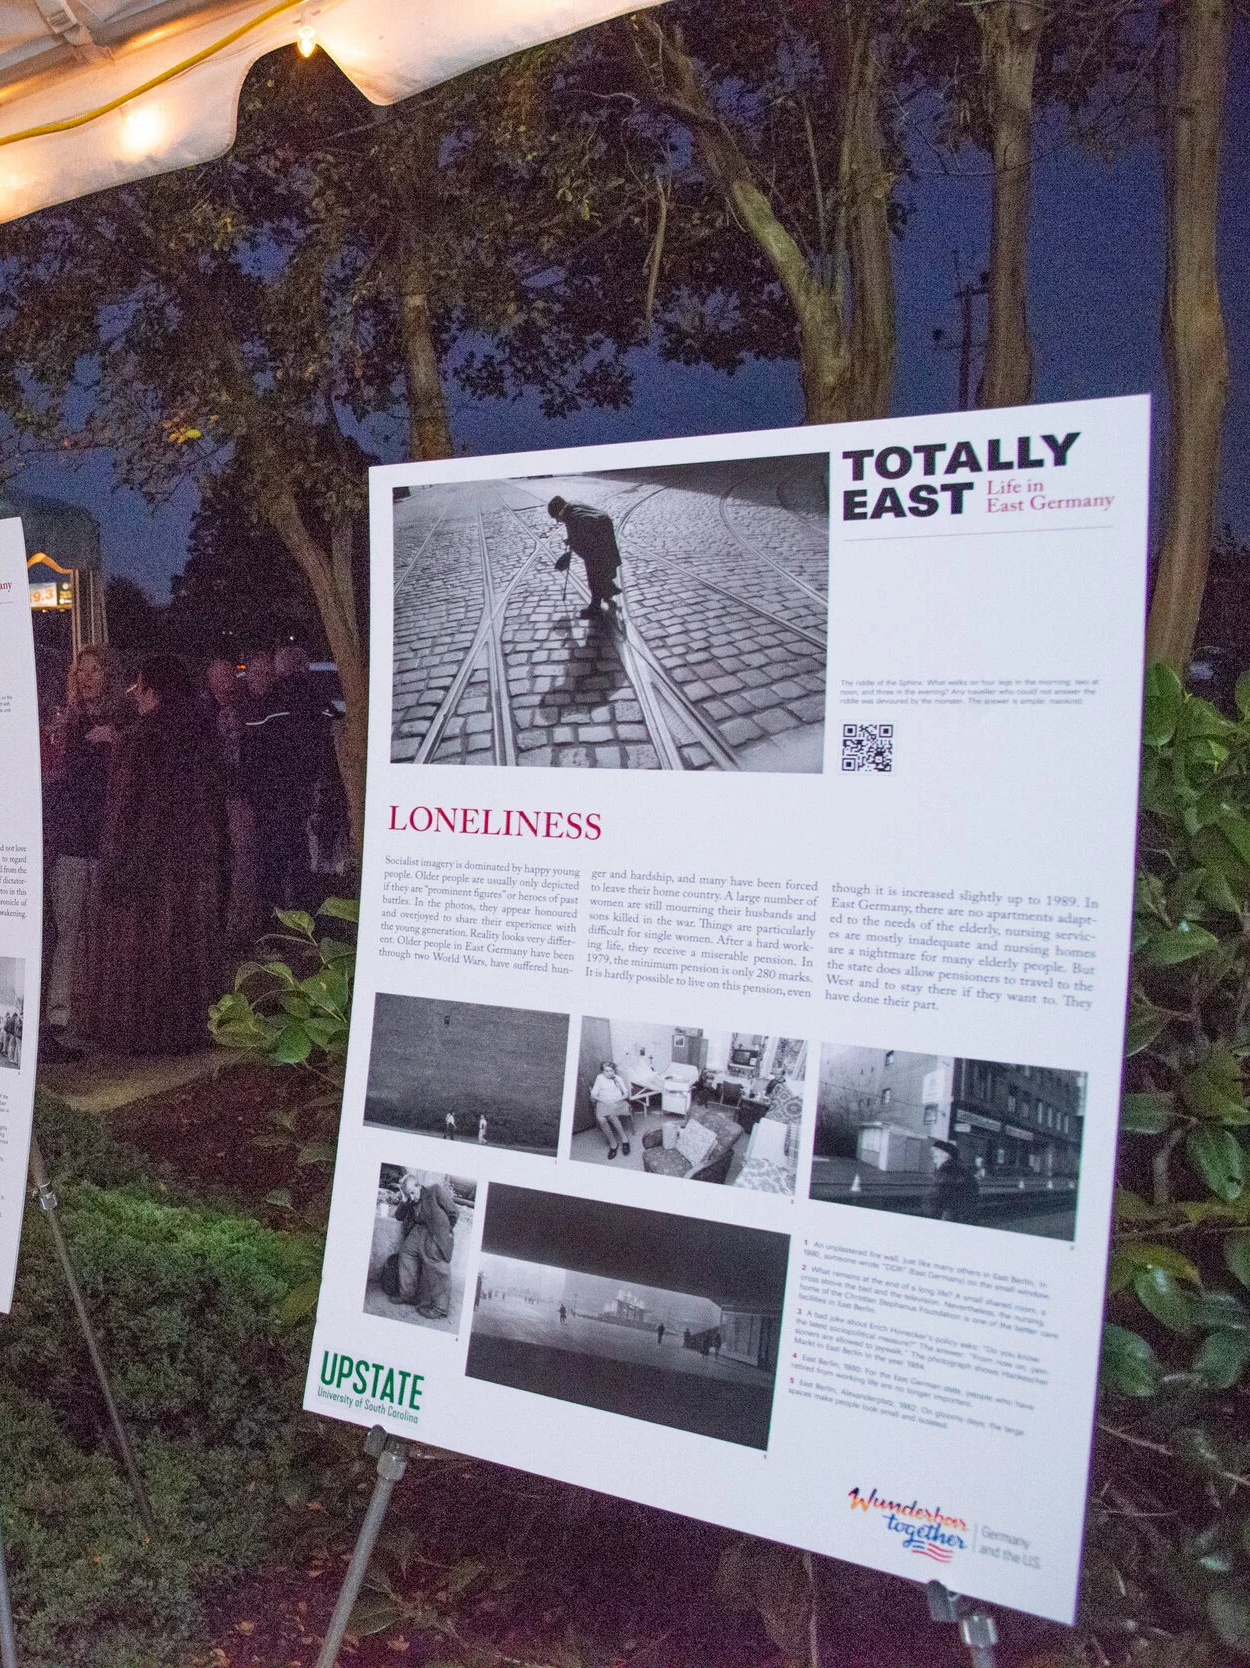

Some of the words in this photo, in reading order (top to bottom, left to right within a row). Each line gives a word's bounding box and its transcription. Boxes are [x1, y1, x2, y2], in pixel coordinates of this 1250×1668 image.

[842, 432, 1082, 481] TOTALLY
[986, 478, 1022, 496] Life
[1027, 480, 1044, 494] in
[843, 482, 974, 521] EAST
[985, 496, 1024, 514] East
[1030, 493, 1115, 512] Germany
[388, 805, 602, 840] LONELINESS
[384, 854, 419, 866] Socialist
[420, 858, 454, 871] imagery
[455, 860, 462, 869] is
[463, 859, 510, 872] dominated
[511, 862, 522, 876] by
[523, 863, 550, 877] happy
[552, 868, 580, 879] young
[414, 870, 440, 881] Older
[441, 872, 470, 886] people
[486, 874, 517, 889] usually
[518, 876, 539, 890] only
[540, 877, 580, 893] depicted
[591, 871, 606, 882] ger
[609, 869, 627, 880] and
[677, 873, 695, 884] and
[699, 877, 726, 889] many
[730, 876, 753, 887] have
[756, 877, 781, 888] been
[785, 879, 818, 891] forced
[383, 881, 389, 891] if
[390, 881, 408, 895] they
[518, 889, 546, 901] heroes
[548, 891, 558, 902] of
[559, 894, 578, 906] past
[590, 882, 600, 891] to
[602, 882, 626, 893] leave
[627, 883, 650, 895] their
[652, 885, 680, 897] home
[724, 890, 733, 900] A
[736, 891, 760, 905] large
[763, 892, 803, 905] number
[806, 895, 818, 906] of
[381, 907, 396, 918] and
[399, 909, 439, 925] overjoyed
[442, 913, 452, 923] to
[455, 913, 477, 924] share
[481, 915, 502, 926] their
[505, 918, 552, 933] experience
[556, 921, 576, 932] with
[414, 897, 424, 908] In
[427, 898, 441, 909] the
[478, 902, 498, 916] they
[501, 906, 530, 918] appear
[534, 905, 578, 918] honoured
[589, 899, 624, 907] women
[626, 901, 641, 909] are
[644, 899, 662, 910] still
[665, 902, 714, 917] mourning
[717, 904, 741, 915] their
[744, 906, 793, 919] husbands
[796, 909, 816, 920] and
[380, 921, 394, 932] the
[394, 925, 420, 937] young
[469, 928, 500, 943] Reality
[501, 930, 525, 942] looks
[526, 935, 545, 946] very
[546, 934, 575, 946] differ-
[378, 947, 411, 963] through
[414, 952, 430, 961] two
[433, 952, 460, 964] World
[490, 957, 510, 968] have
[512, 959, 548, 971] suffered
[551, 962, 573, 973] hun-
[396, 936, 421, 948] Older
[423, 938, 451, 953] people
[453, 942, 462, 951] in
[464, 941, 484, 953] East
[486, 943, 528, 959] Germany
[530, 947, 550, 958] have
[552, 948, 574, 960] been
[320, 1350, 425, 1411] UPSTATE
[317, 1386, 354, 1408] University
[354, 1397, 363, 1408] of
[364, 1399, 386, 1415] South
[387, 1405, 419, 1424] Carolina
[848, 1487, 967, 1531] Wunderbar
[882, 1514, 967, 1549] together
[981, 1525, 1030, 1549] Germany
[979, 1545, 1001, 1558] and
[1002, 1549, 1021, 1564] the
